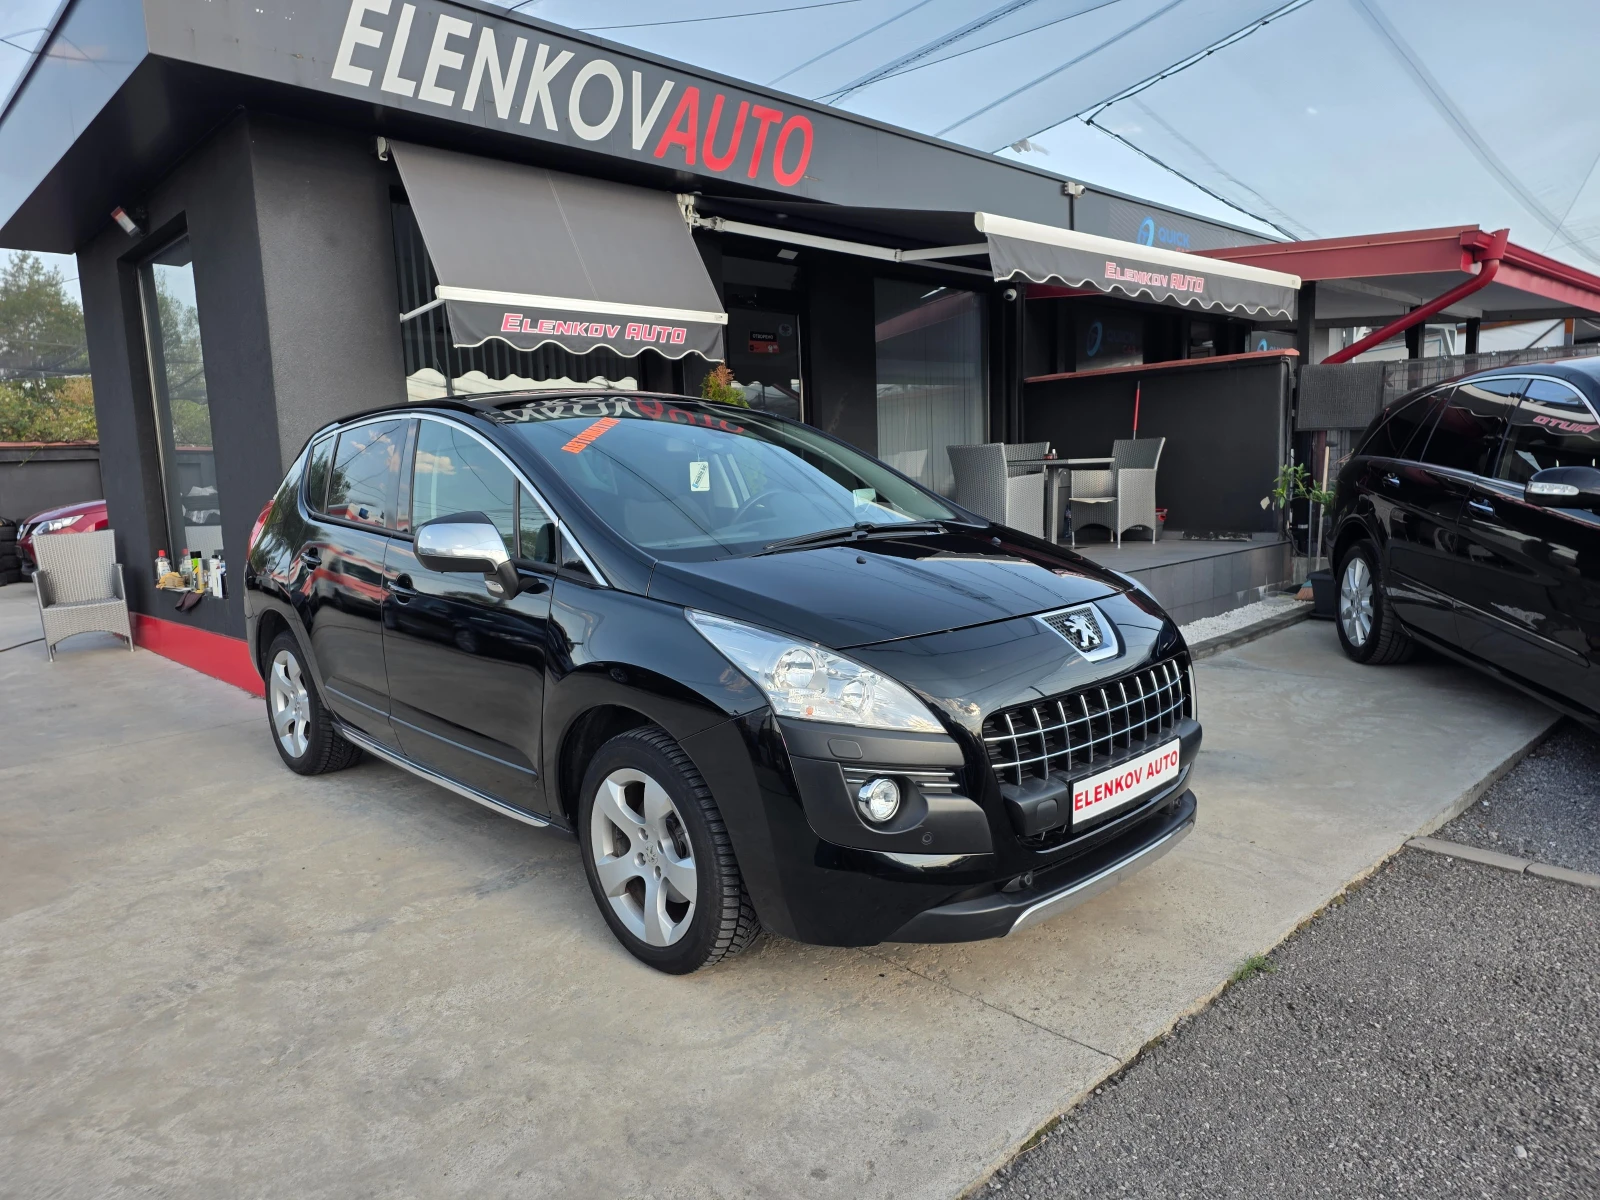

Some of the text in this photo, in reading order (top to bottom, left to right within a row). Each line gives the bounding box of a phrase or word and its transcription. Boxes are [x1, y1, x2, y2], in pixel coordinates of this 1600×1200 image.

[1158, 227, 1190, 248] QUICK
[1170, 273, 1204, 293] AUTO
[501, 313, 687, 344] ELENKOV AUTO
[1074, 750, 1178, 811] ELENKOV AUTO
